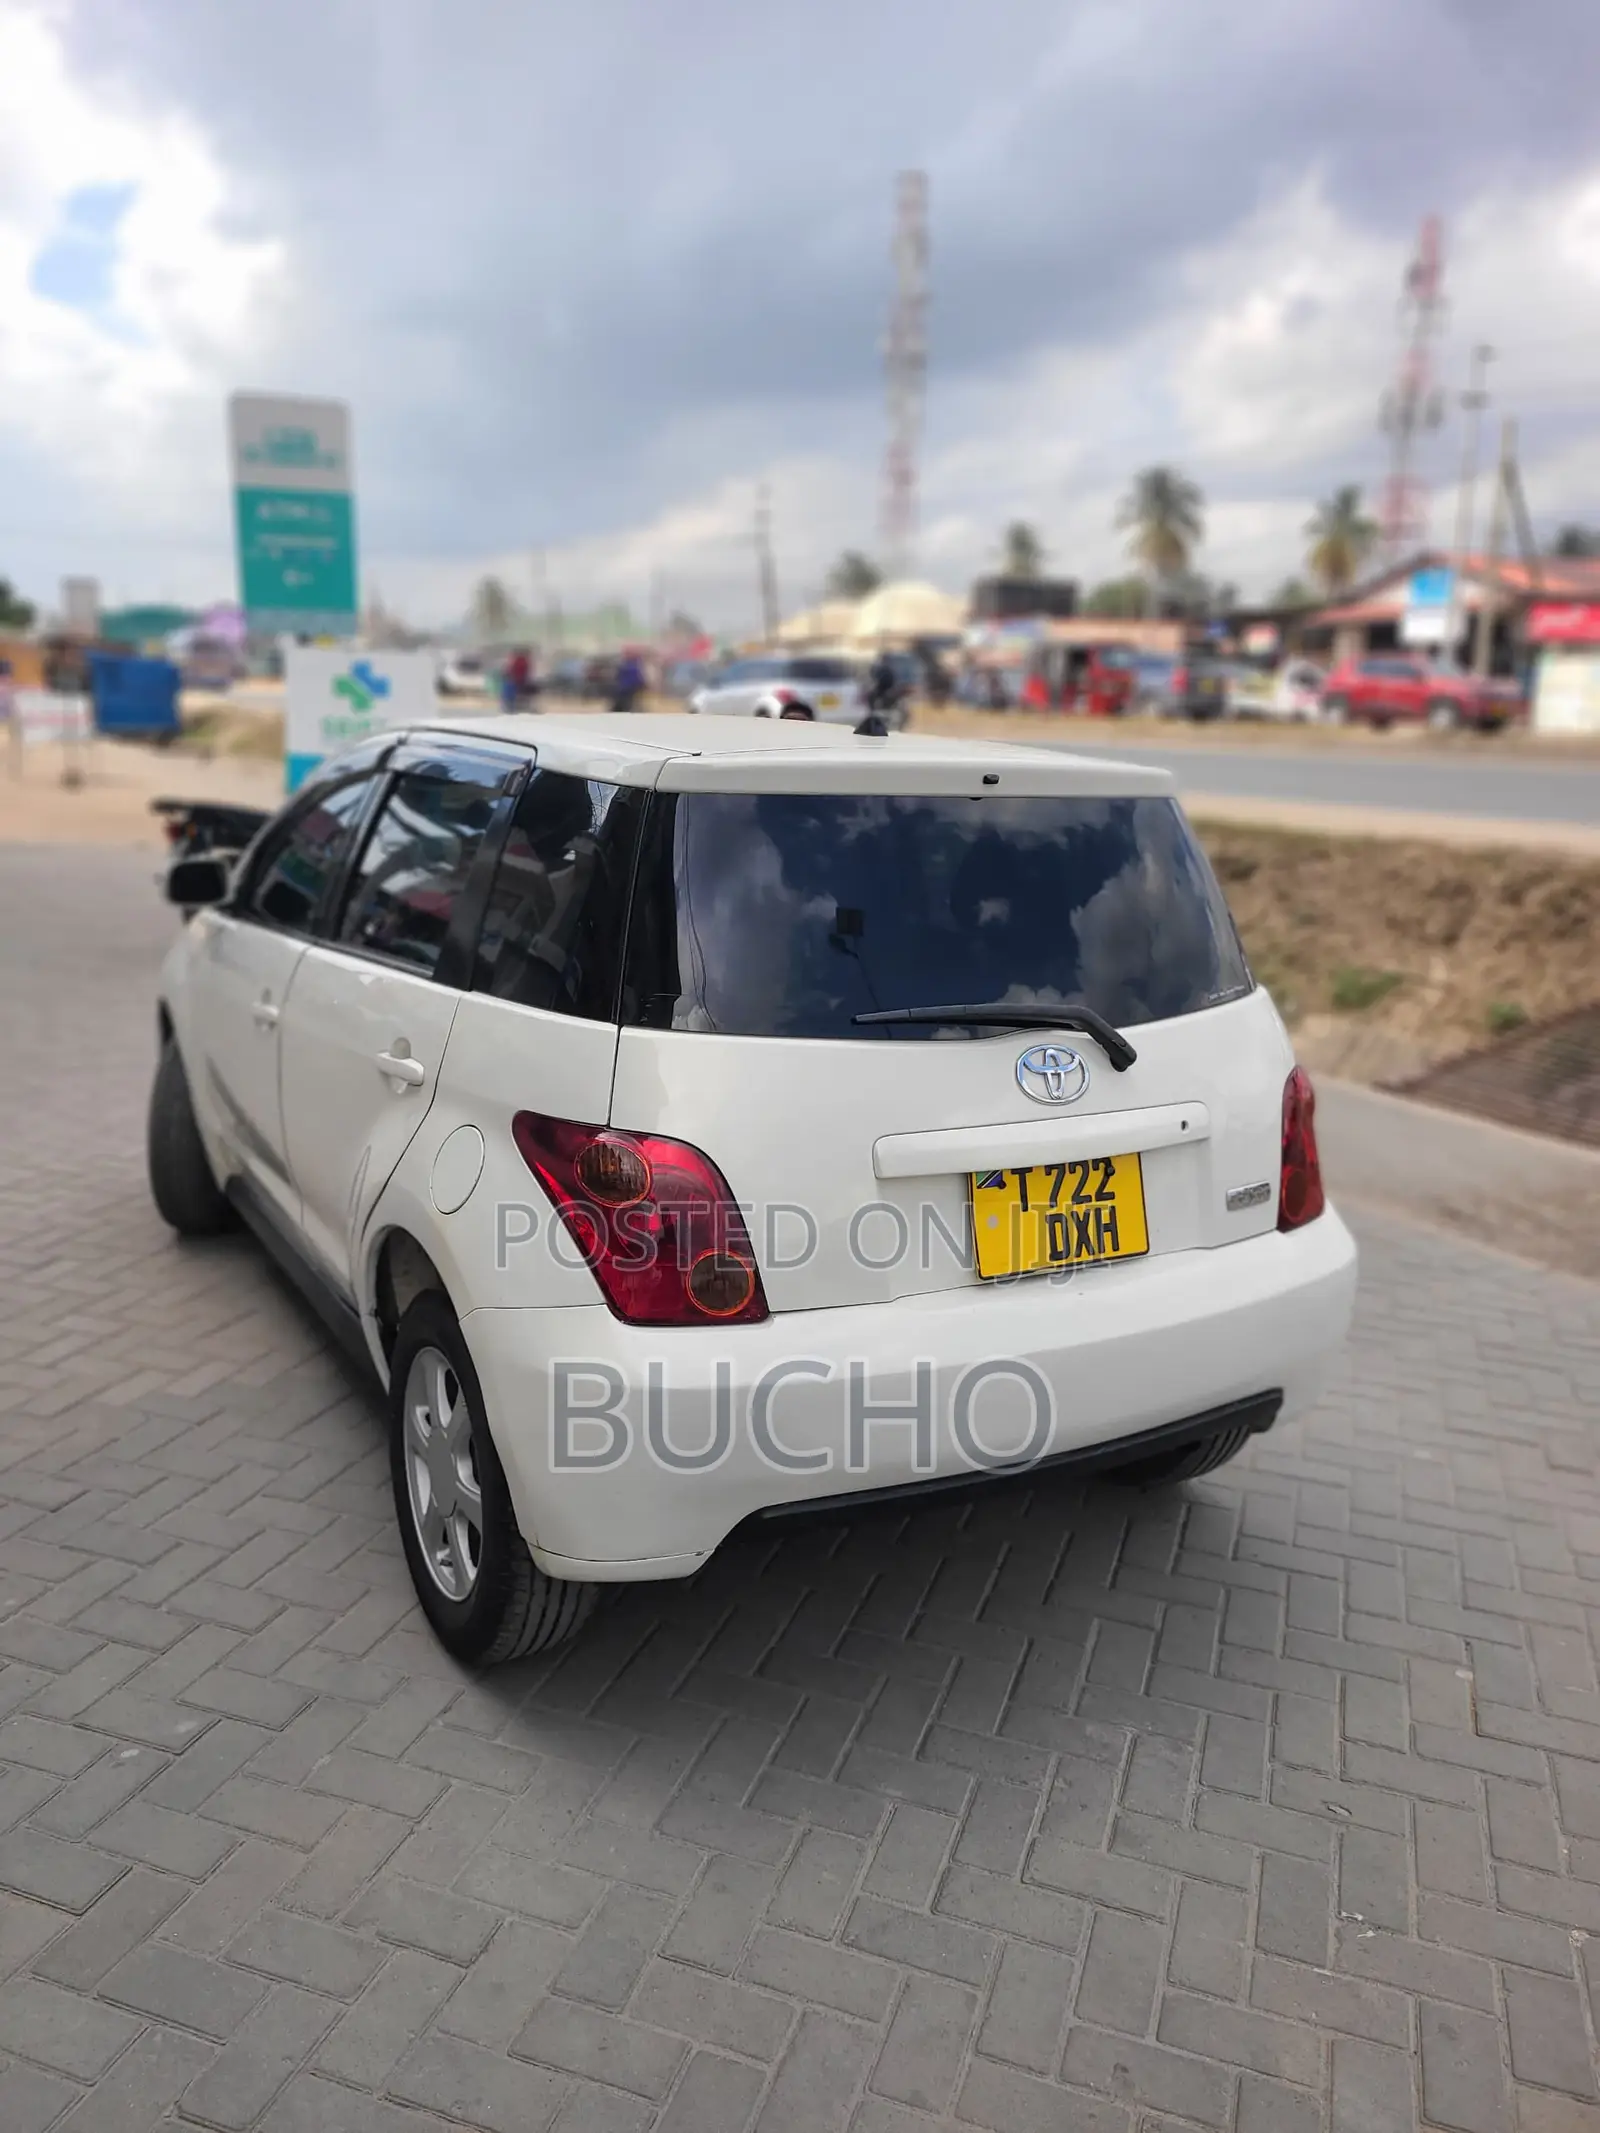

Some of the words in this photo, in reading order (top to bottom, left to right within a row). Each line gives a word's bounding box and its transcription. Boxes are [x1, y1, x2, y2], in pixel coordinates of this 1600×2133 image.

[1010, 1167, 1034, 1213] T
[1044, 1157, 1116, 1208] 722
[1045, 1205, 1120, 1262] DXH
